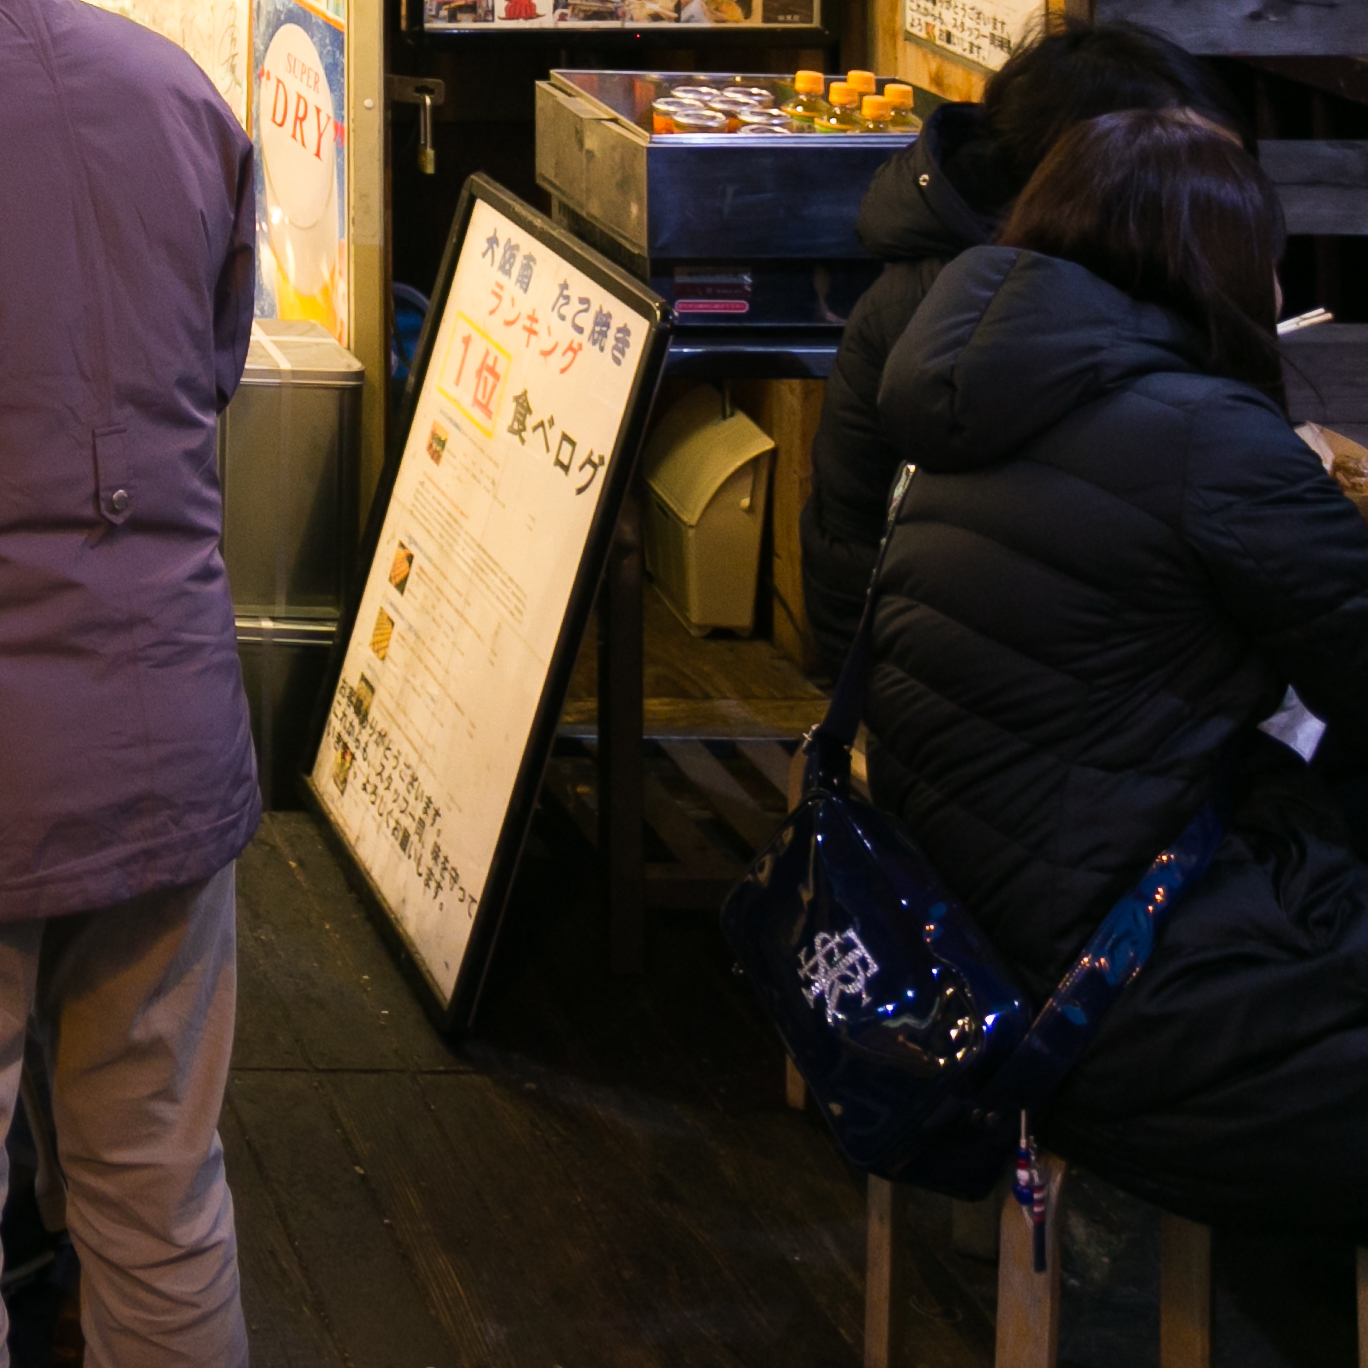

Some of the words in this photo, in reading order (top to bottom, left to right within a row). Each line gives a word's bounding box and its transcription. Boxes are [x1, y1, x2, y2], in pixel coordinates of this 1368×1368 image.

[286, 52, 320, 95] SUPER
[487, 281, 584, 375] ランキング
[550, 278, 632, 367] たこ焼き
[453, 333, 501, 421] 1位
[506, 387, 605, 497] 食べログ
